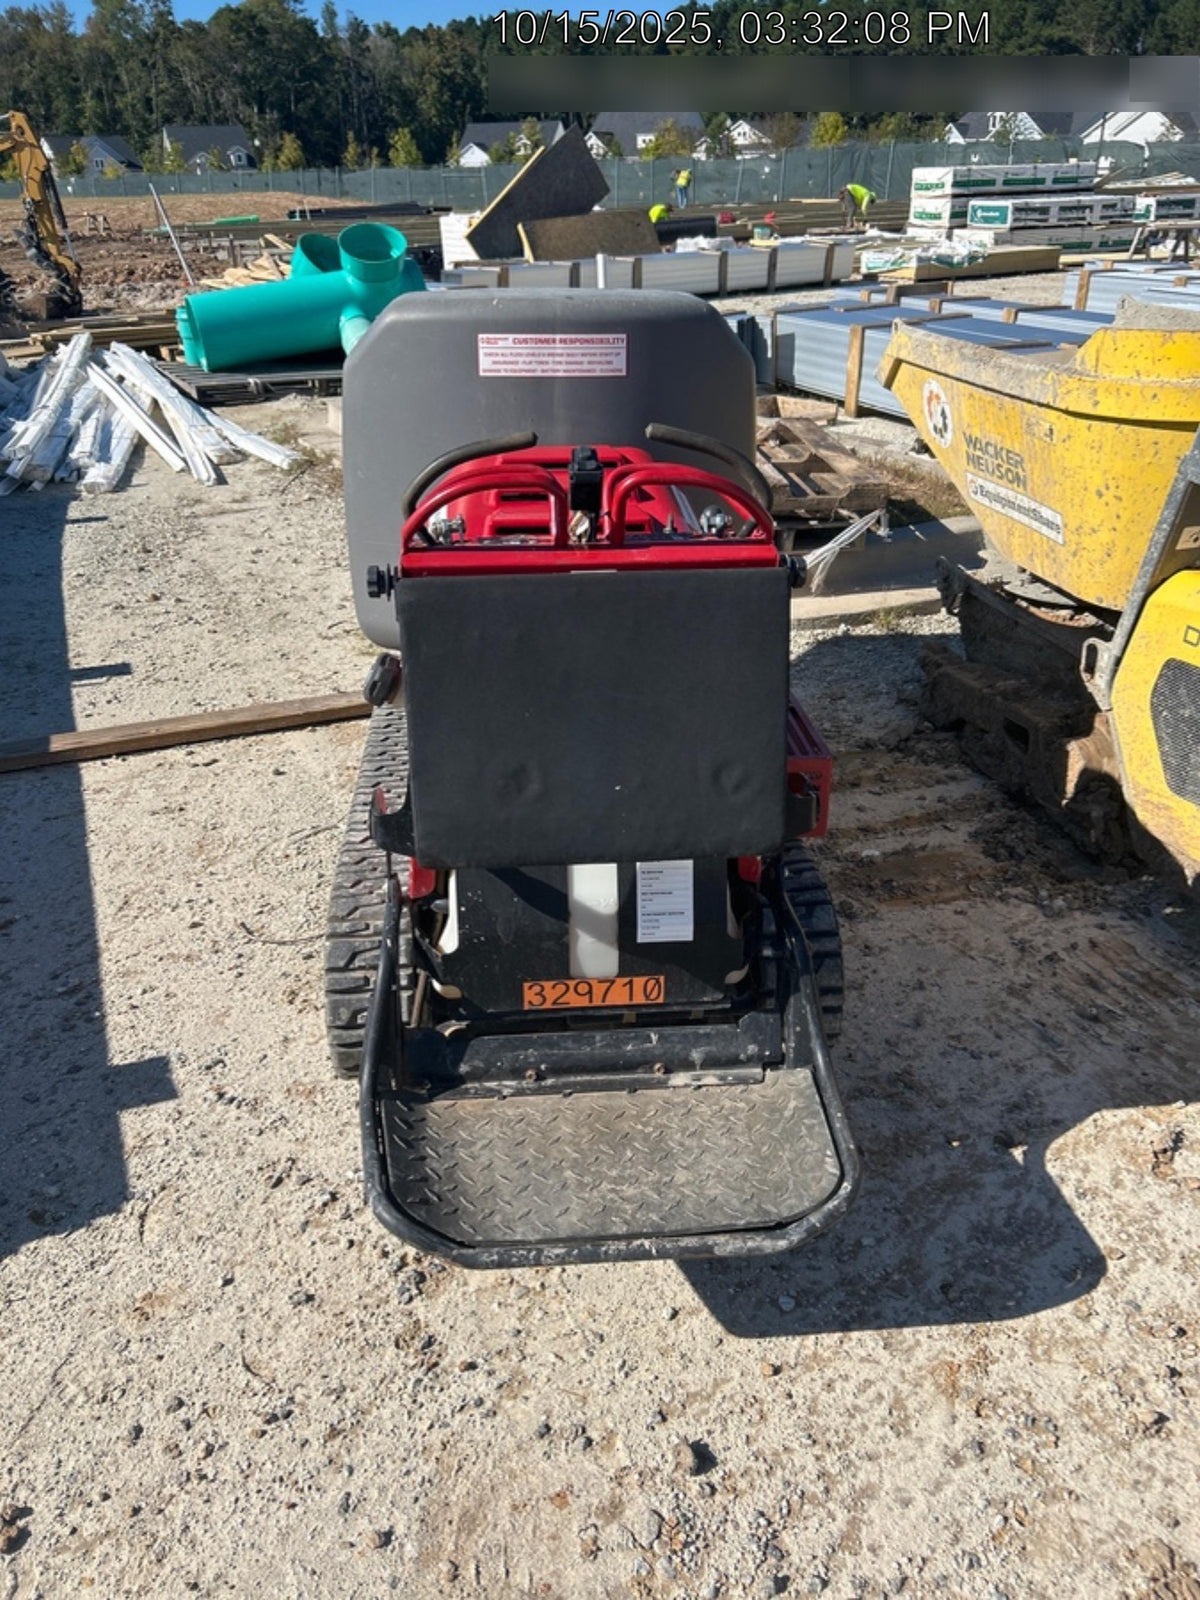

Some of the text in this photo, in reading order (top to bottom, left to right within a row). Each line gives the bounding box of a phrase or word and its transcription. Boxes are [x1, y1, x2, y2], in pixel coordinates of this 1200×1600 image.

[512, 337, 557, 346] CUSTOMER
[559, 337, 625, 346] RESPONSIBILITY
[962, 431, 1026, 473] WACKER
[965, 451, 1028, 492] NEUSON
[527, 977, 662, 1007] 329710
